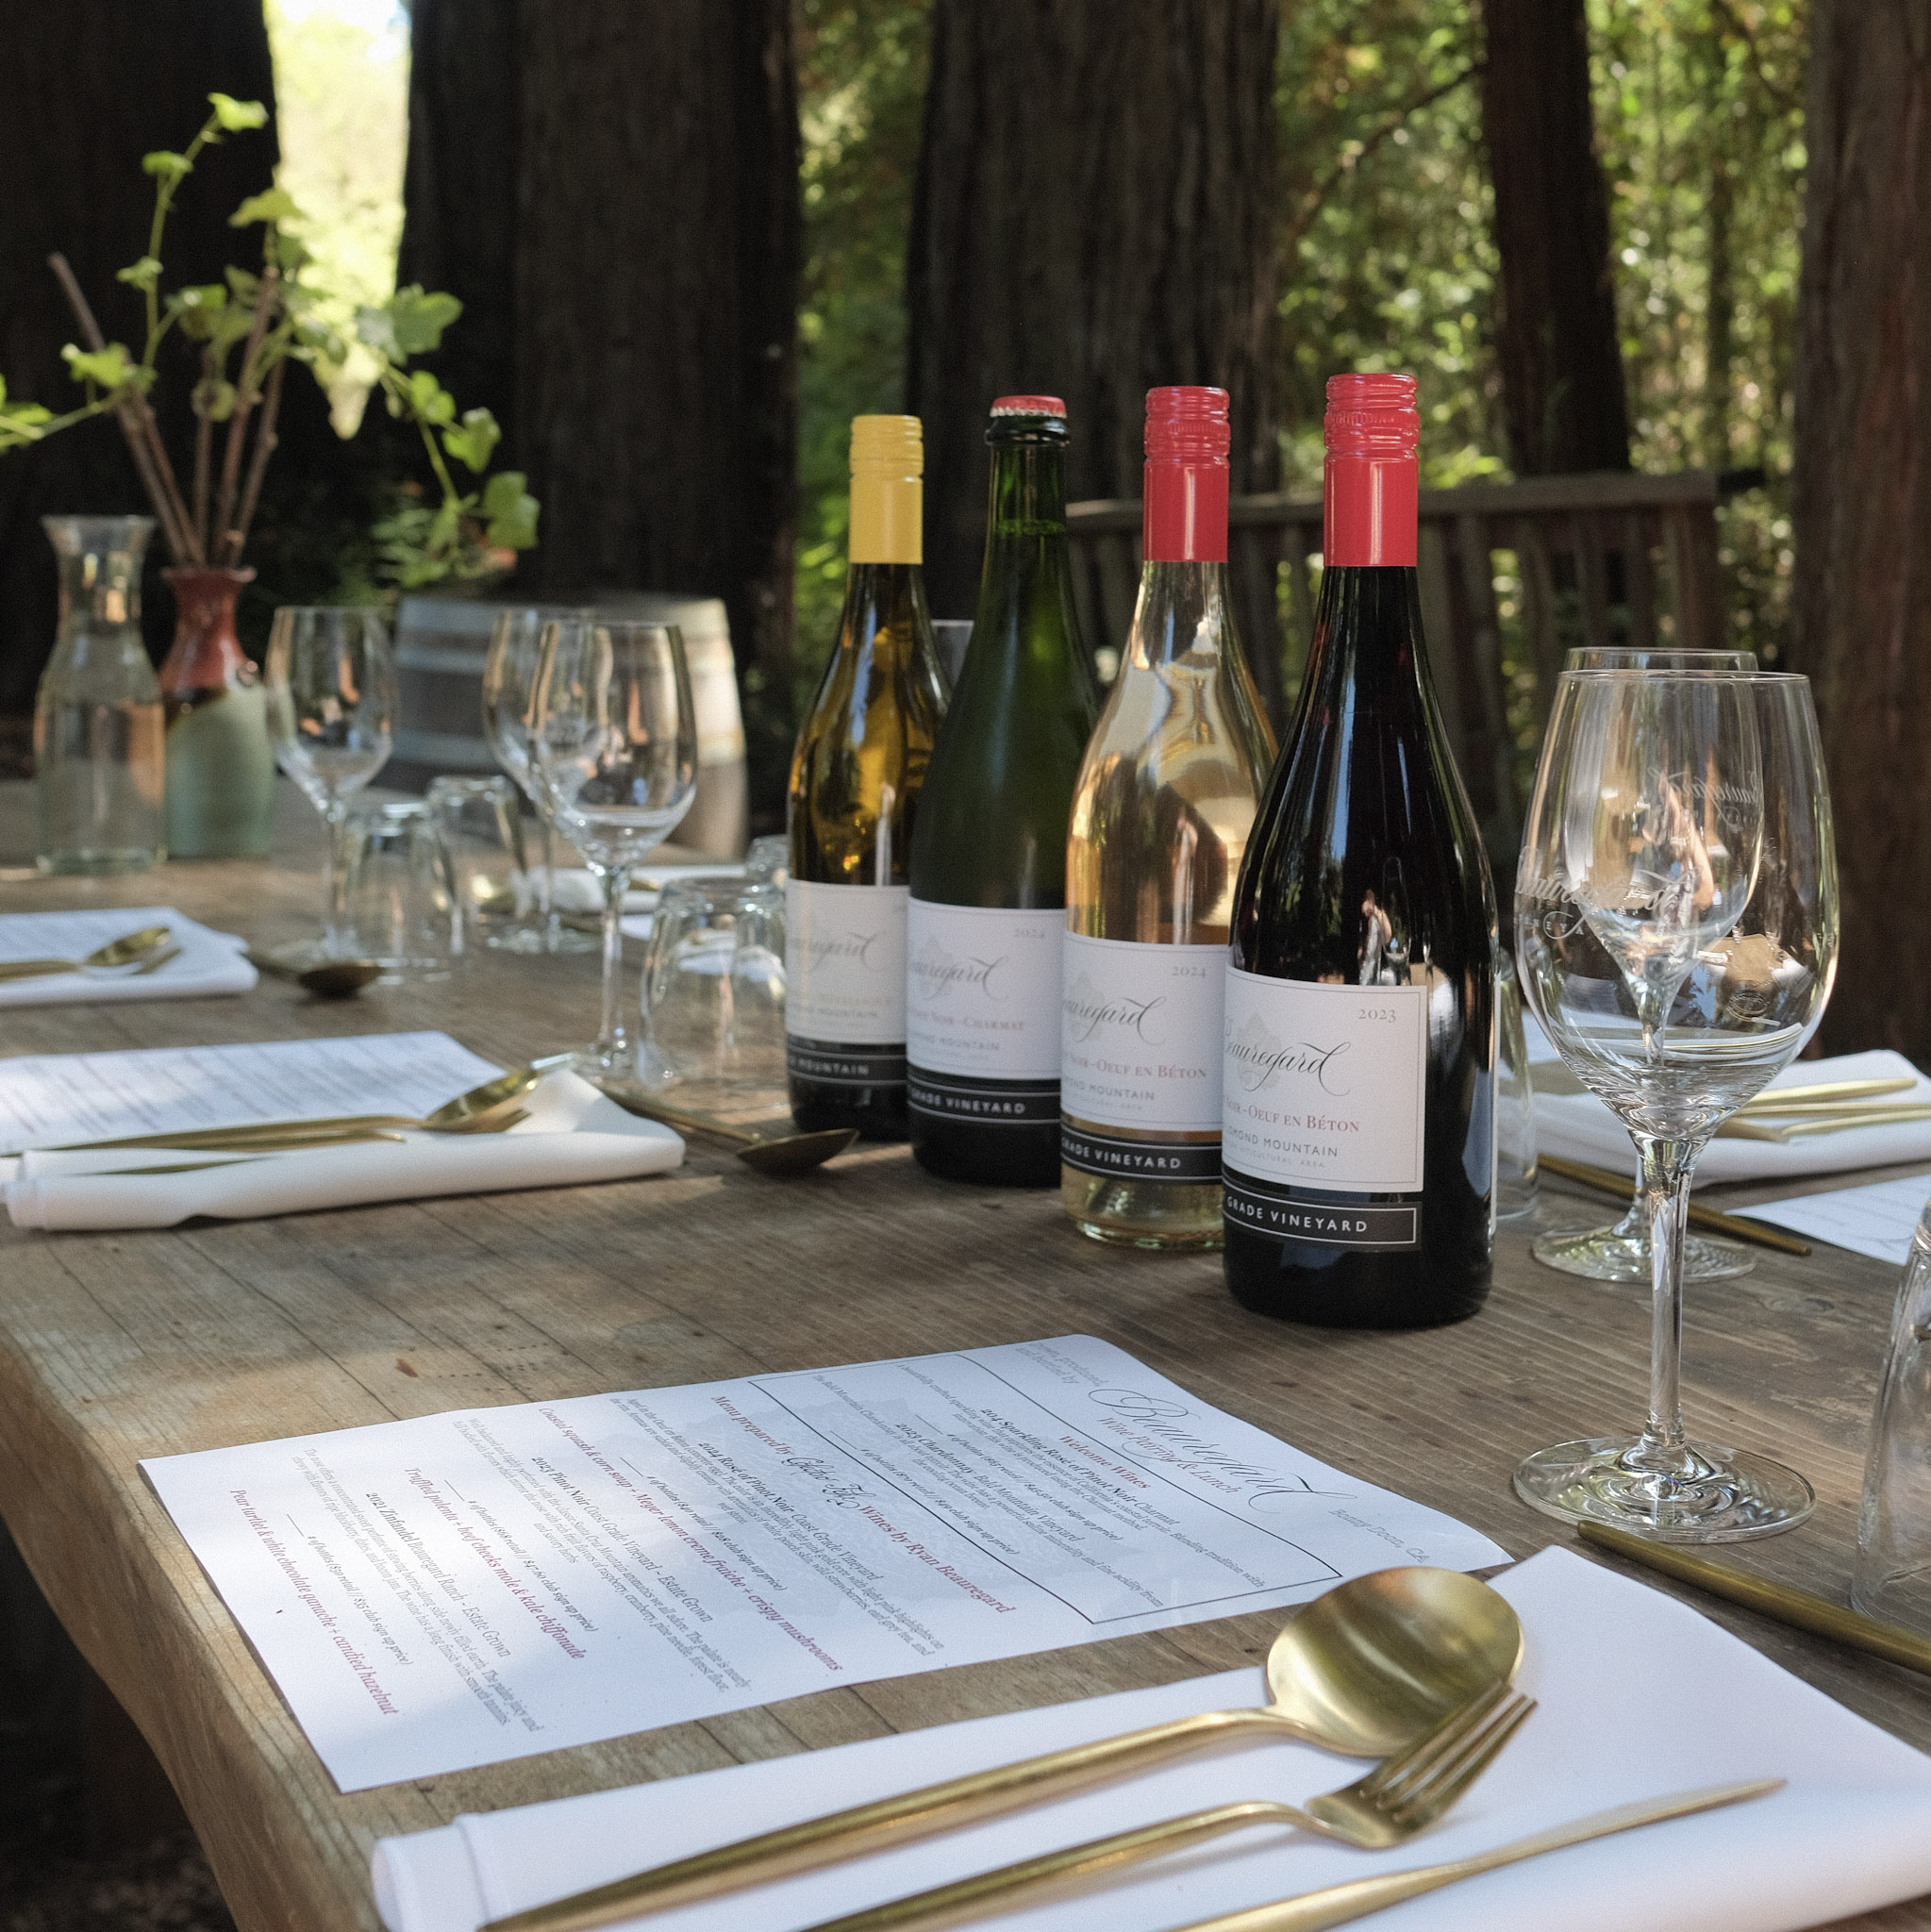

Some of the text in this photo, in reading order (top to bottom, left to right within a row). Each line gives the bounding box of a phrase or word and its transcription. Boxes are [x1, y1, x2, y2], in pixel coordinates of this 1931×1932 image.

[1171, 966, 1208, 979] 2024
[1357, 1008, 1397, 1024] 2023
[1088, 1084, 1156, 1101] MOUNTAIN
[945, 1096, 1025, 1114] VINEYARD
[1262, 1137, 1340, 1158] MOUNTAIN
[1094, 1149, 1182, 1169] VINEYARD
[1226, 1195, 1369, 1233] GRADE VINEYARD
[997, 1420, 1048, 1450] Sparkling
[1041, 1448, 1075, 1465] Rosé
[1057, 1435, 1151, 1489] Welcome Wines
[1089, 1389, 1356, 1514] Beauregard
[1095, 1416, 1135, 1436] Wine
[1188, 1469, 1242, 1493] Lunch
[1066, 1463, 1090, 1472] of
[404, 1466, 441, 1495] Truffled
[893, 1423, 1086, 1542] 2023 Chardonnay Bald Mountain Vineyard
[1077, 1470, 1114, 1489] Pinot
[709, 1395, 741, 1417] Menu
[729, 1415, 787, 1447] prepared
[774, 1445, 795, 1456] by
[857, 1505, 897, 1533] Wines
[888, 1530, 912, 1543] by
[904, 1542, 941, 1566] Ryan
[934, 1564, 1016, 1613] Beauregard
[1106, 1486, 1138, 1503] Noir
[423, 1493, 458, 1522] polenta
[696, 1441, 885, 1581] 2024 Rosé of Pinot Noir Coast Grade Vineyard
[1132, 1501, 1180, 1525] Charmat
[456, 1525, 485, 1542] beef
[530, 1456, 713, 1623] 2023 Pinot Noir Coast Grade Vineyard Estate Grown
[538, 1407, 572, 1430] Coastal
[560, 1428, 594, 1452] squash
[591, 1456, 615, 1473] corn
[607, 1471, 633, 1488] soup
[631, 1492, 664, 1516] Meyer
[656, 1514, 689, 1538] lemon
[681, 1536, 715, 1561] creme
[746, 1593, 785, 1622] crispy
[777, 1621, 843, 1671] mushrooms
[312, 1543, 335, 1564] bottles
[470, 1541, 502, 1568] cheeks
[325, 1562, 344, 1576] ($50
[364, 1491, 511, 1657] 2021 Zinfandel Beauregard Ranch Estate Grown
[474, 1507, 498, 1527] bottles
[489, 1525, 513, 1540] ($68
[502, 1538, 527, 1555] retail
[521, 1558, 547, 1579] $47.60
[540, 1578, 561, 1592] club
[551, 1591, 571, 1606] sign
[568, 1612, 600, 1632] price)
[492, 1567, 522, 1589] mole
[336, 1574, 360, 1592] retail
[228, 1489, 251, 1507] Pear
[240, 1507, 269, 1530] tartlet
[260, 1536, 287, 1557] white
[275, 1557, 312, 1593] chocolate
[296, 1592, 338, 1627] ganache
[331, 1635, 374, 1671] candied
[357, 1670, 399, 1715] hazelnut
[352, 1597, 370, 1609] $35
[517, 1594, 545, 1614] kale
[360, 1607, 383, 1623] club
[371, 1621, 390, 1637] sign
[535, 1613, 587, 1658] chiffonade
[384, 1644, 414, 1666] price)
